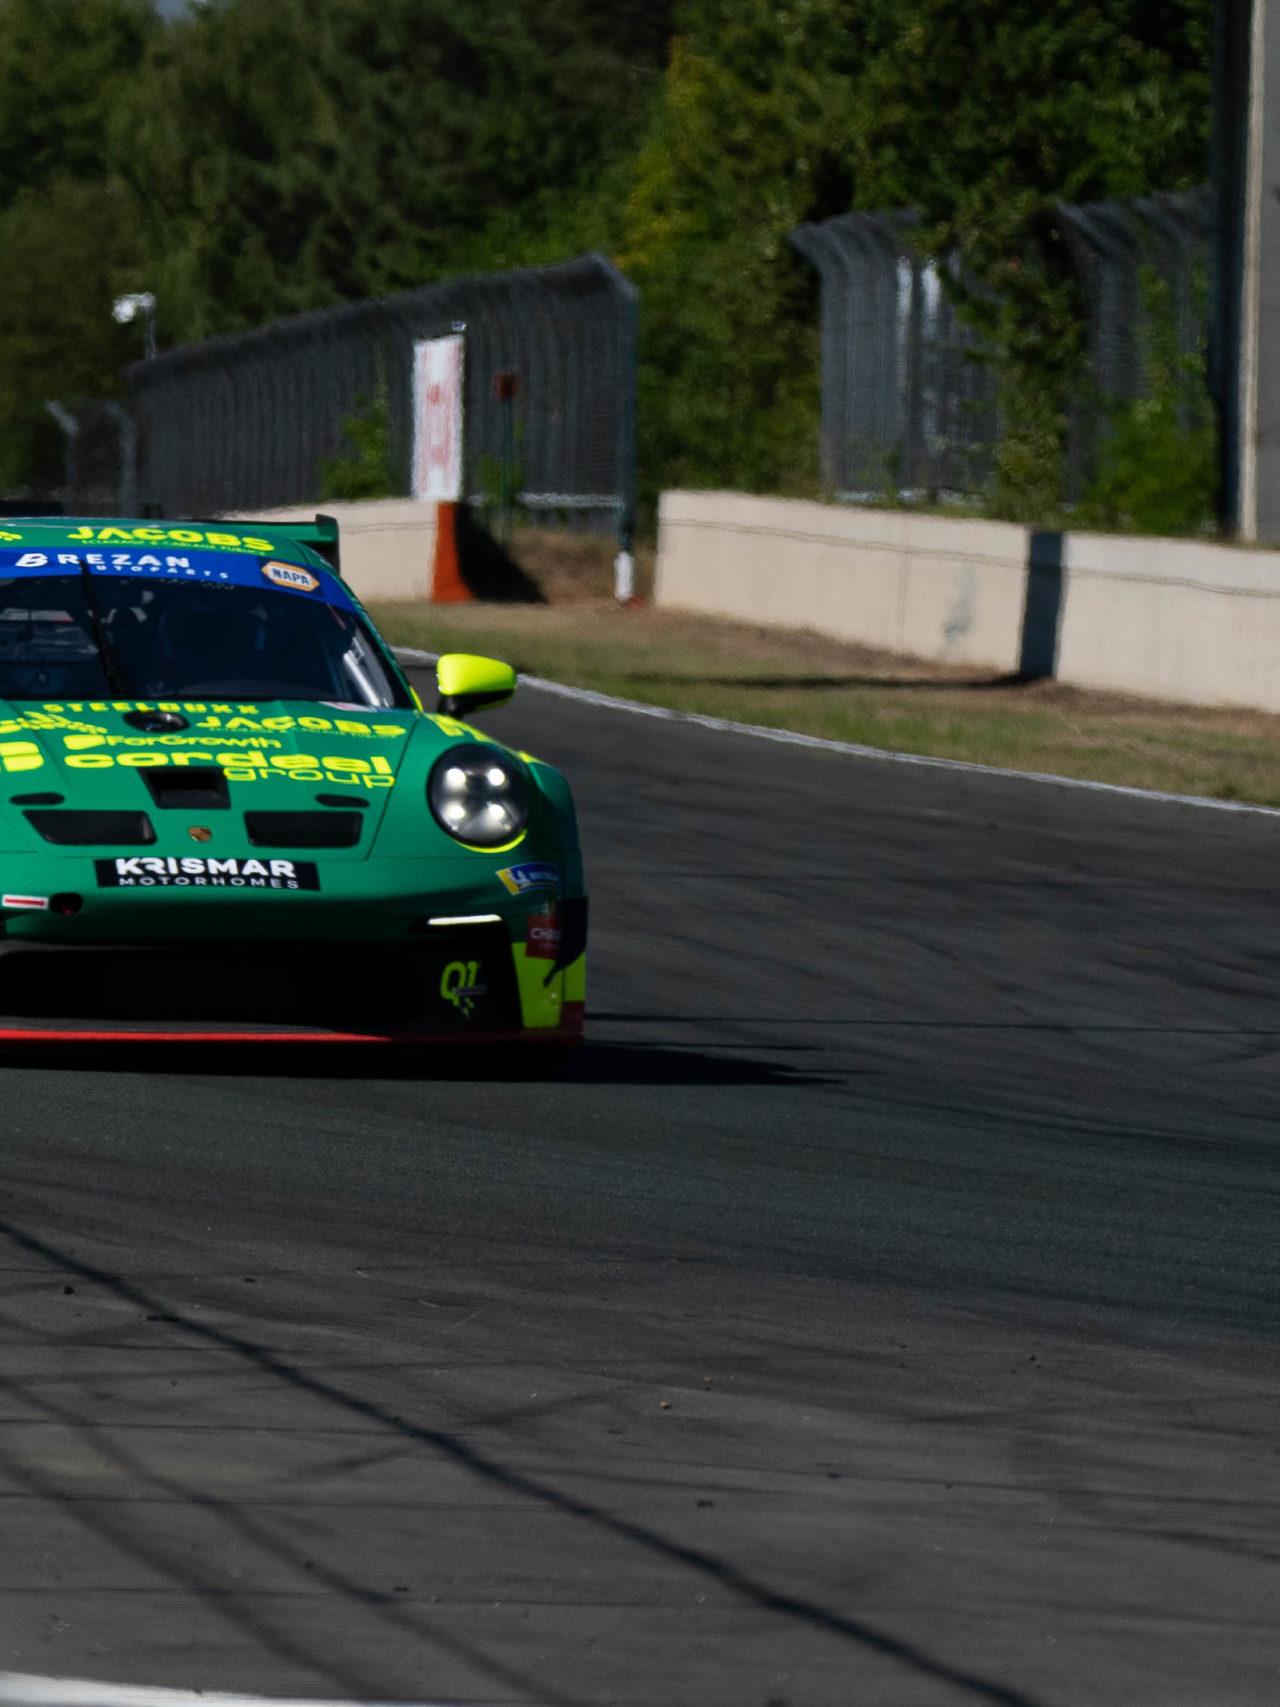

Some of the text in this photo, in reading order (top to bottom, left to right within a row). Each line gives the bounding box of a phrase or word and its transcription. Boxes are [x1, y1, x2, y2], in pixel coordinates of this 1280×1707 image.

[67, 526, 275, 551] JACOBS
[78, 564, 229, 579] UTOPARTS
[271, 566, 312, 588] NAPA
[196, 715, 408, 737] JACOBS
[105, 734, 282, 749] ForGrowth
[64, 751, 393, 774] cordeel
[223, 767, 395, 789] group
[115, 857, 296, 878] KRISMAR
[120, 876, 299, 889] MOTORHOMES
